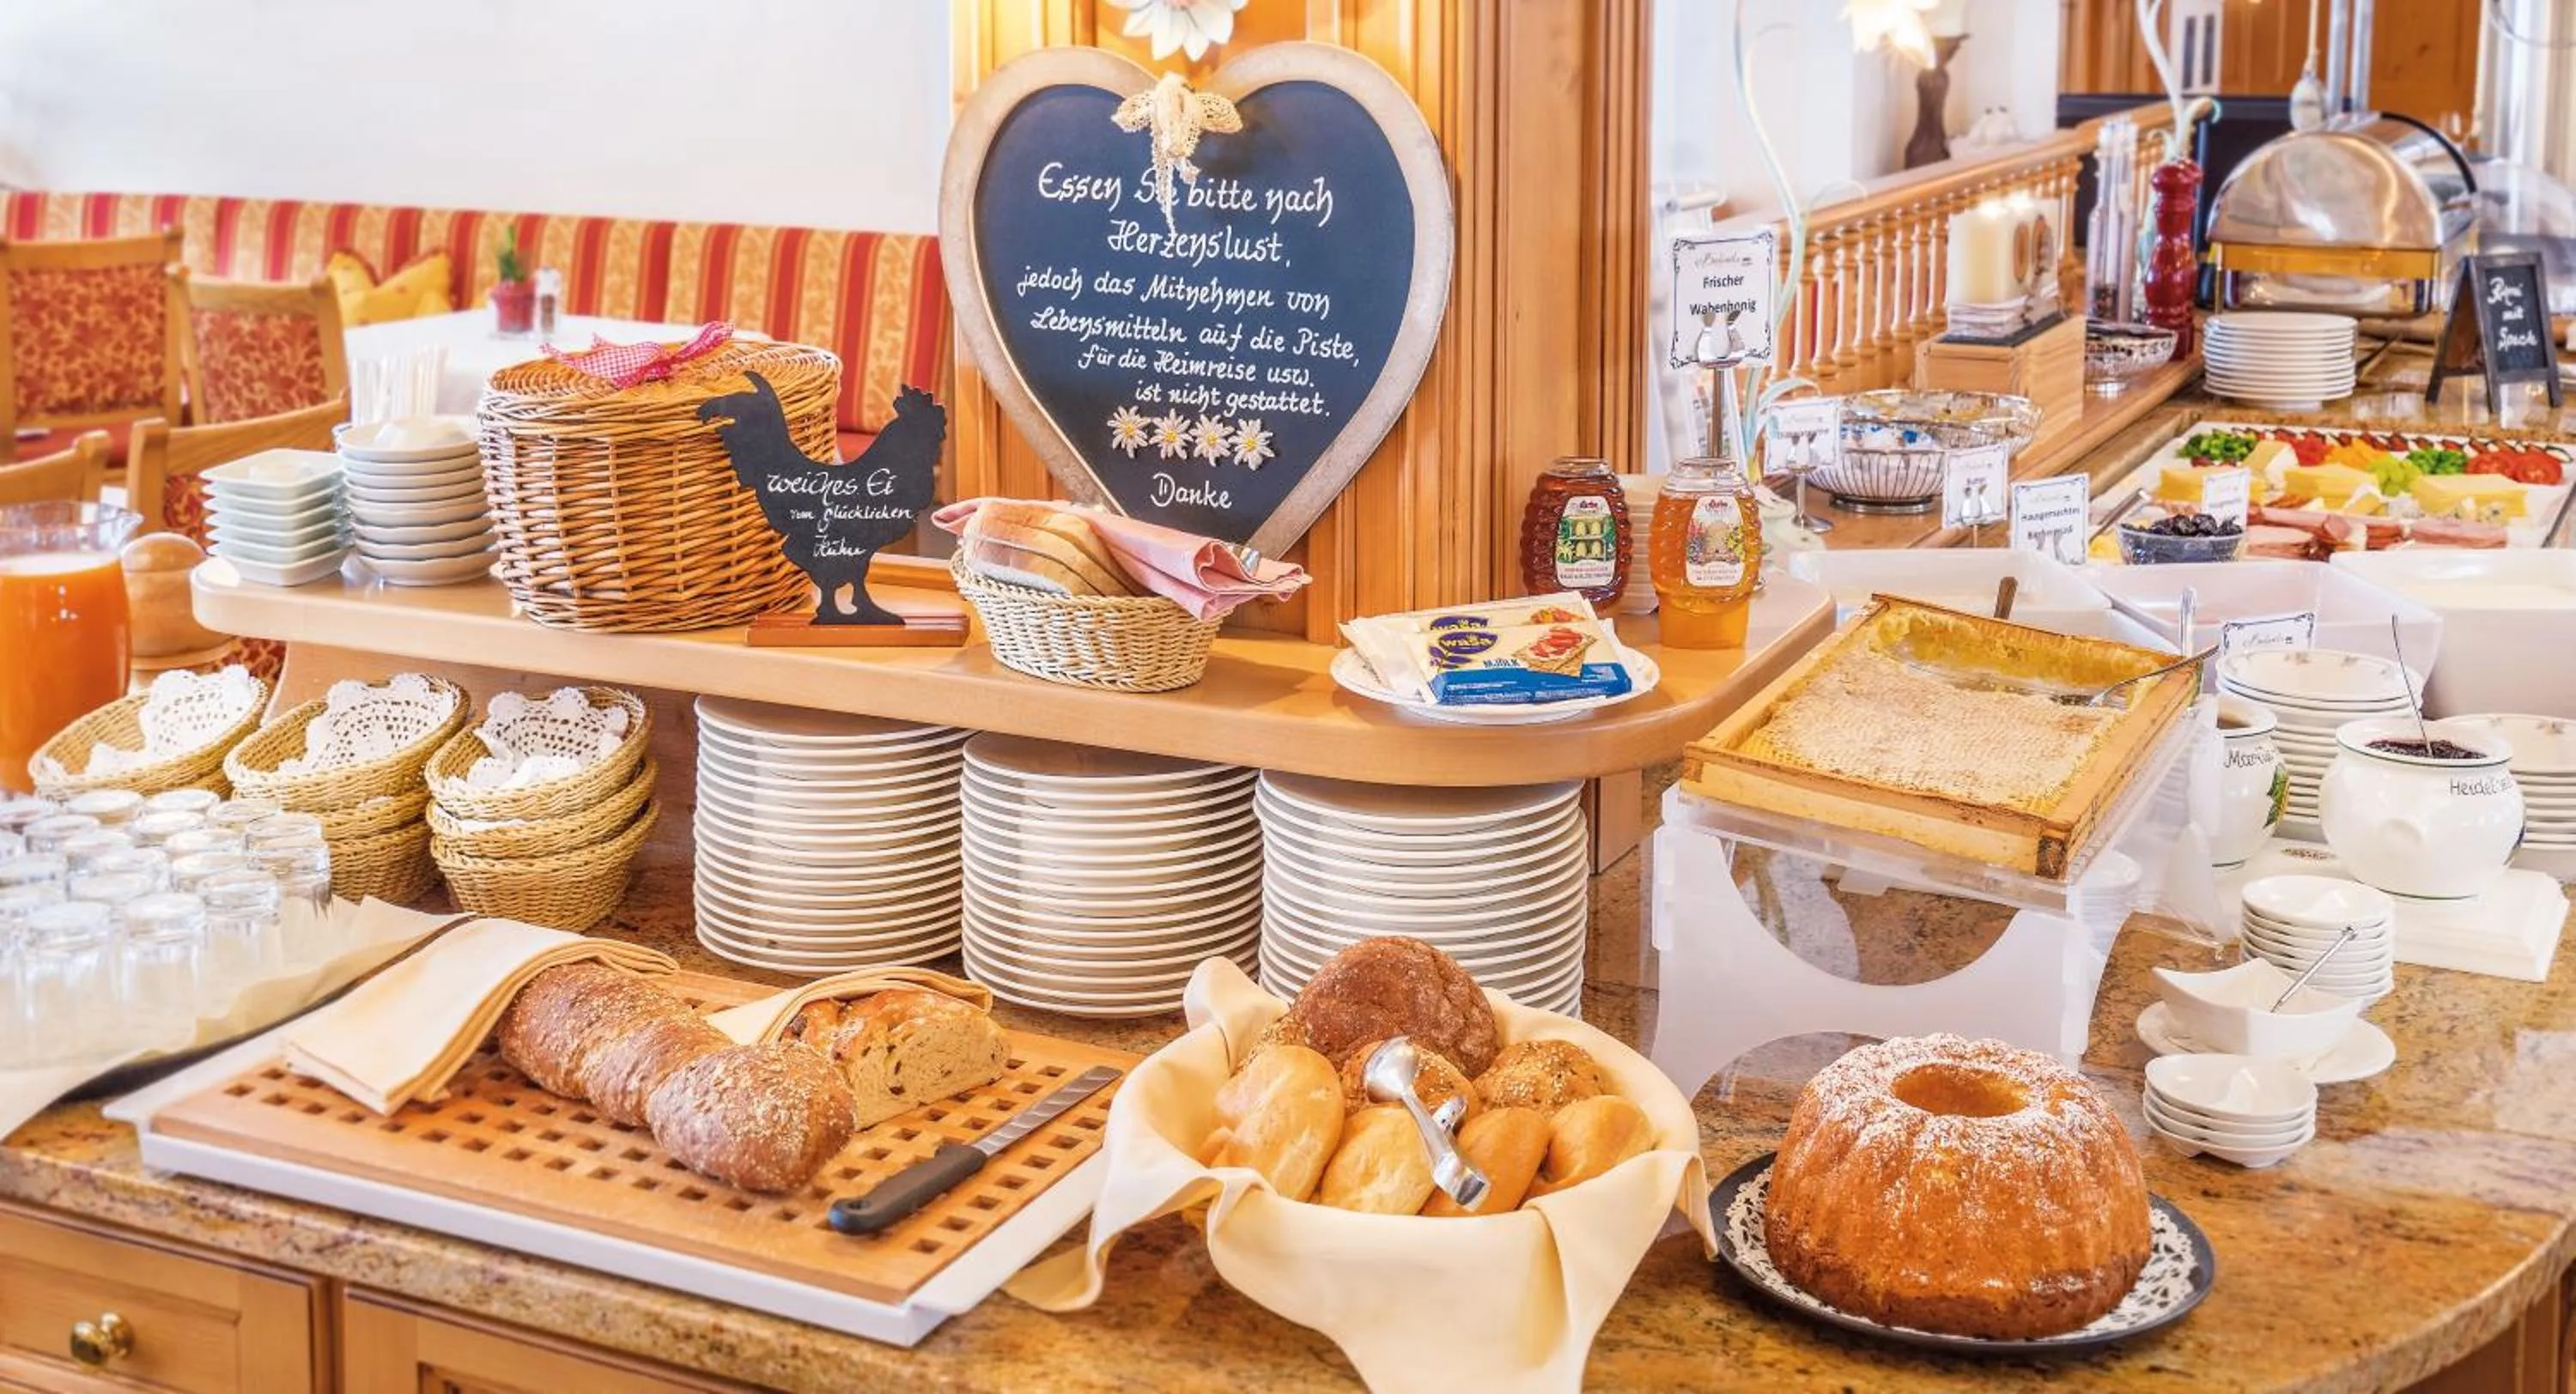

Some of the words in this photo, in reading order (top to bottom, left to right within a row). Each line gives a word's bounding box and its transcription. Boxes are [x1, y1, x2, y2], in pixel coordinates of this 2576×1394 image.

[1038, 161, 1121, 212] Essen
[1134, 168, 1180, 203] Se
[1188, 177, 1257, 212] bitte
[1265, 177, 1333, 227] nach
[1017, 265, 1083, 300] jedoch
[1093, 270, 1135, 296] das
[1139, 274, 1275, 314] Mitnehmen
[1287, 290, 1331, 320] von
[1703, 274, 1745, 289] Frischer
[1689, 298, 1757, 316] Wabenhonig
[1030, 306, 1187, 343] Lebensmitteln
[1199, 321, 1243, 351] auf
[1249, 325, 1285, 353] die
[1292, 326, 1361, 367] Piste,
[1078, 343, 1115, 369] für
[1118, 352, 1148, 371] die
[1153, 348, 1257, 381] Heimreise
[1267, 369, 1315, 387] usw.
[1135, 379, 1162, 403] ist
[1168, 384, 1222, 415] nicht
[1225, 391, 1331, 418] gestattet.
[866, 468, 897, 496] Ei
[1150, 471, 1233, 509] Danke
